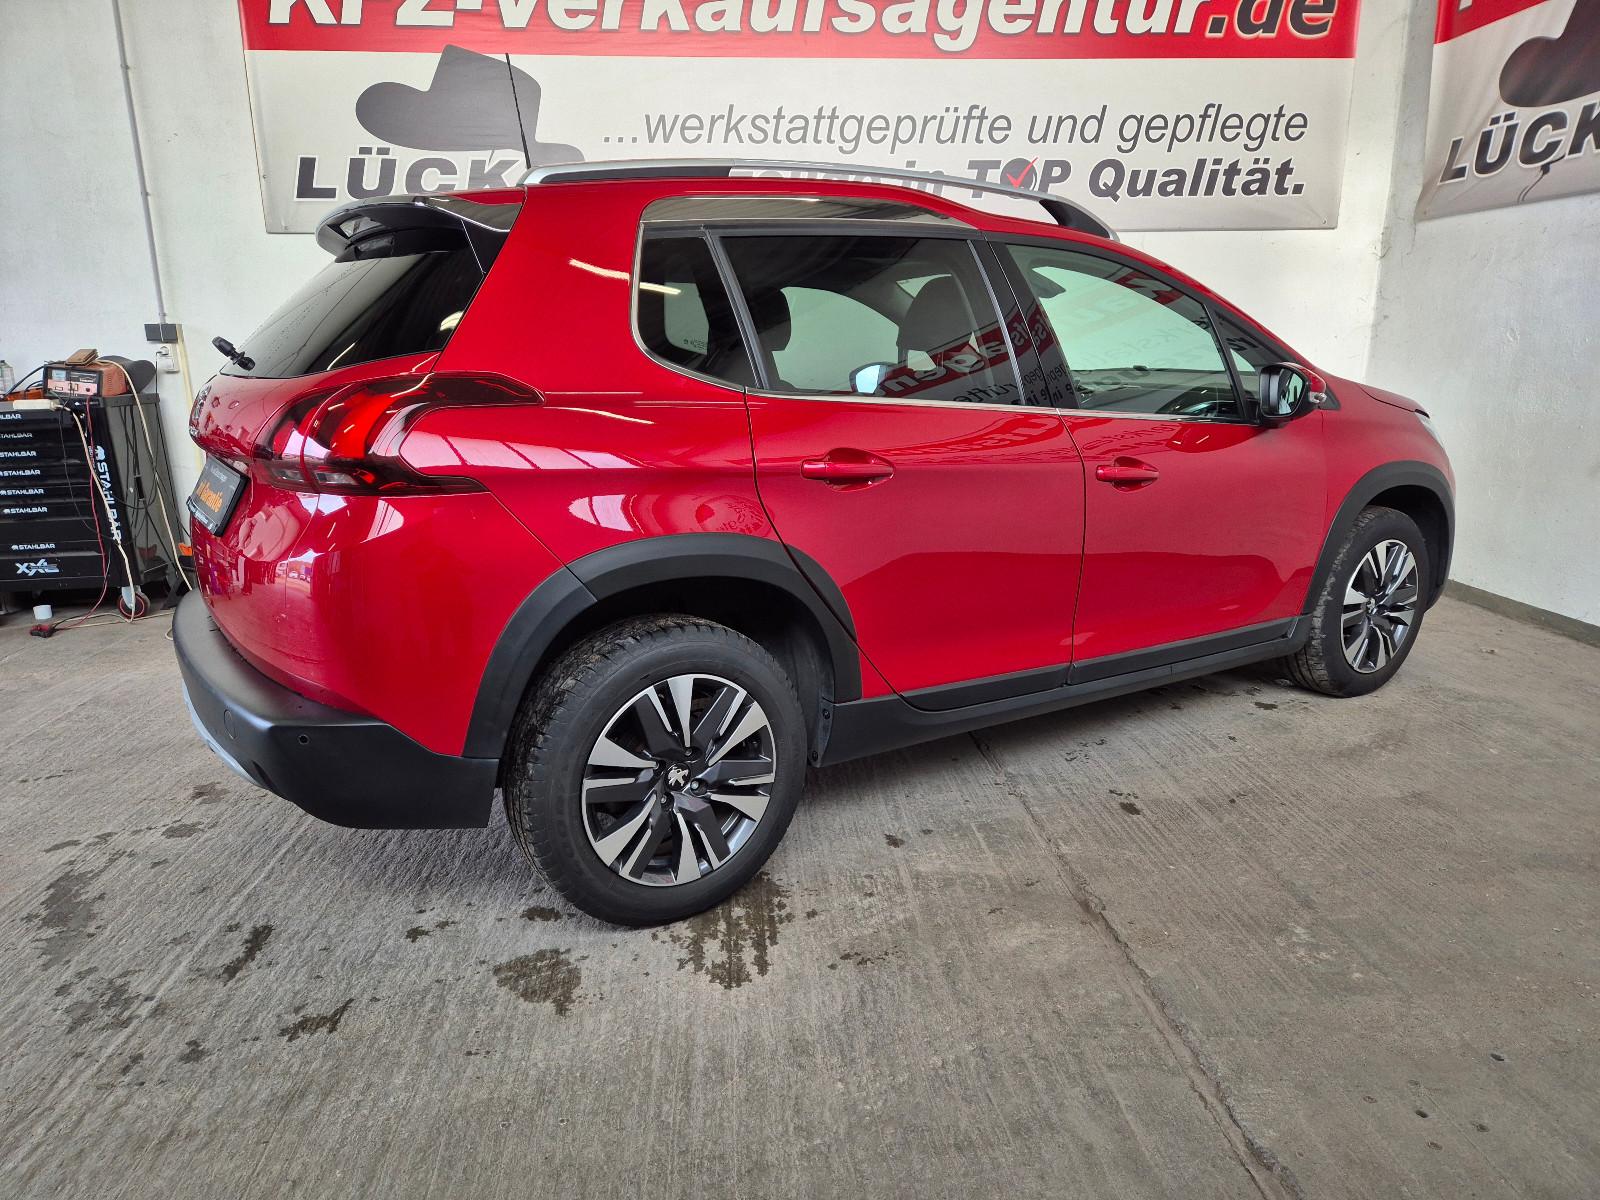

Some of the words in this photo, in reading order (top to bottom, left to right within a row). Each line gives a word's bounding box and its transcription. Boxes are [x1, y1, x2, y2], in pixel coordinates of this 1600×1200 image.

[603, 104, 1012, 155] ...werkstattgeprüfte
[1028, 105, 1107, 144] und
[1117, 103, 1308, 153] gepflegte
[1089, 158, 1304, 202] Qualität.
